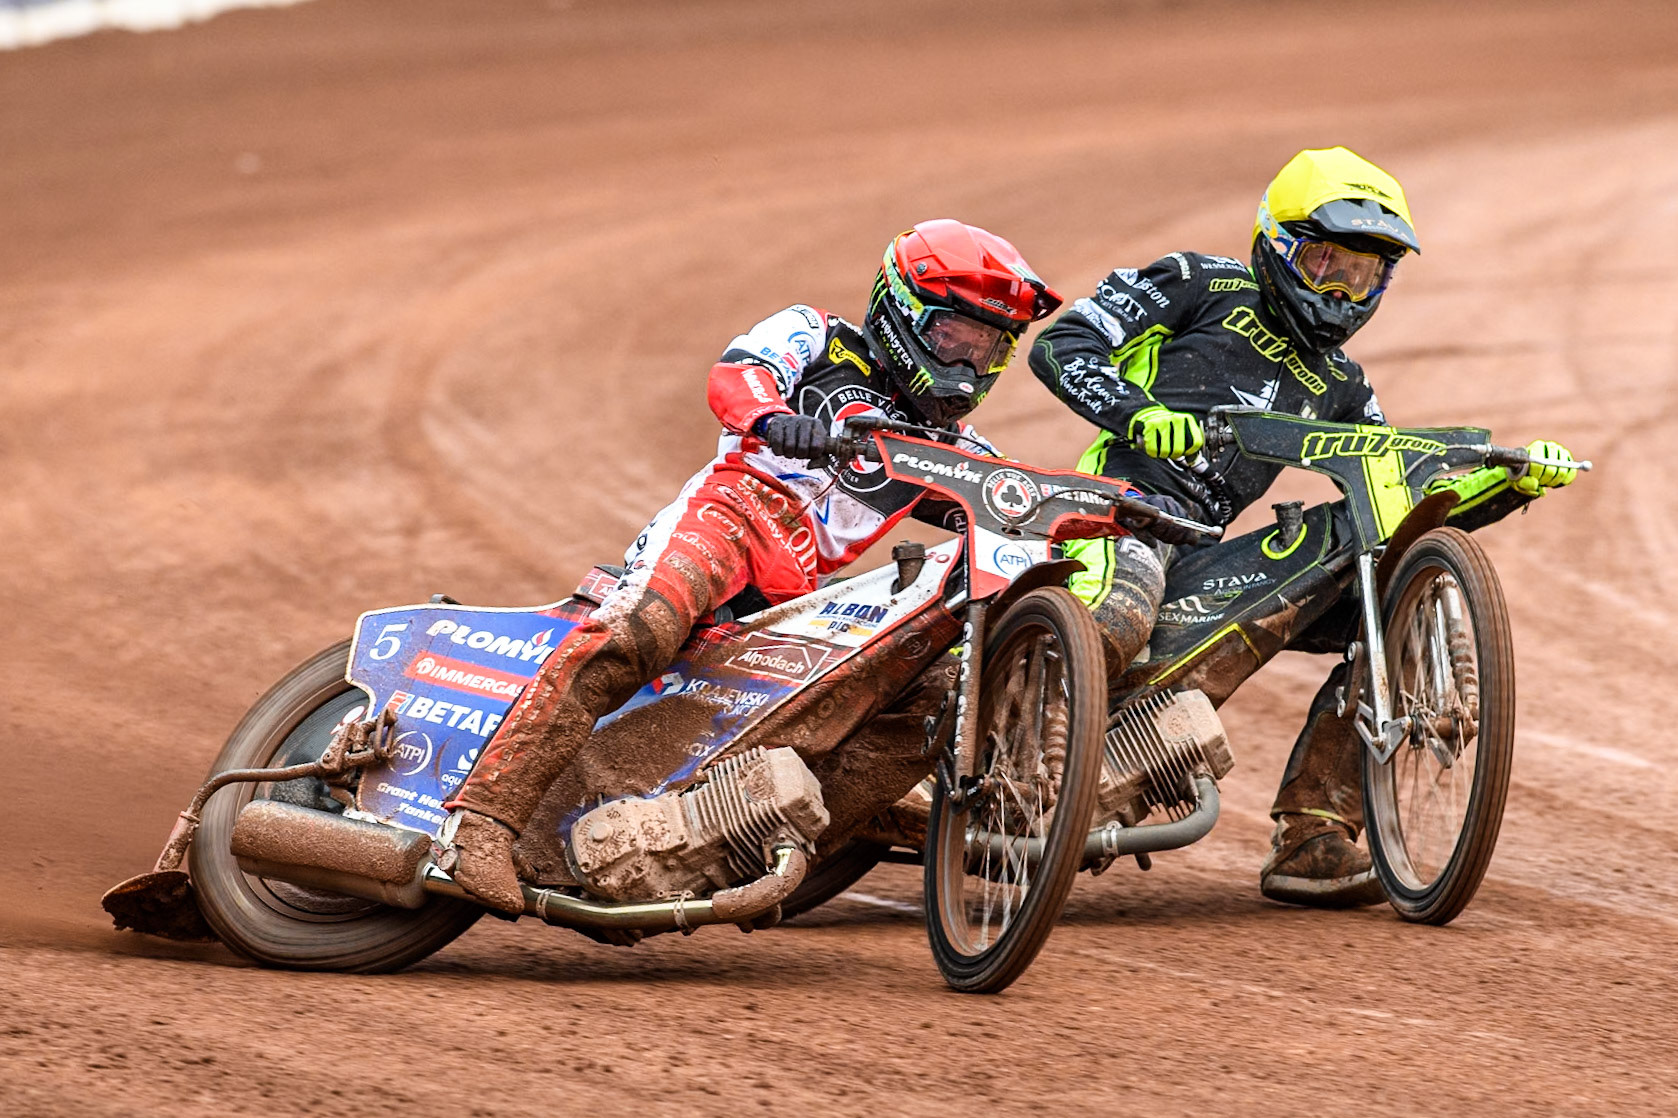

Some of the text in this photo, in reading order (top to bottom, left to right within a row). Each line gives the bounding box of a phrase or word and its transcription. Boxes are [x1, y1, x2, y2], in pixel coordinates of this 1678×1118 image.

[875, 315, 914, 370] MONSTER
[838, 390, 872, 403] BELLE
[1301, 432, 1391, 460] tru7
[1000, 554, 1027, 568] ATPI
[1203, 572, 1267, 590] STAVA
[819, 601, 888, 623] ALBON
[1158, 611, 1180, 621] SEX
[369, 623, 408, 660] 5
[738, 651, 805, 674] Alpodach
[398, 743, 425, 763] ATPI
[377, 782, 418, 801] Grant
